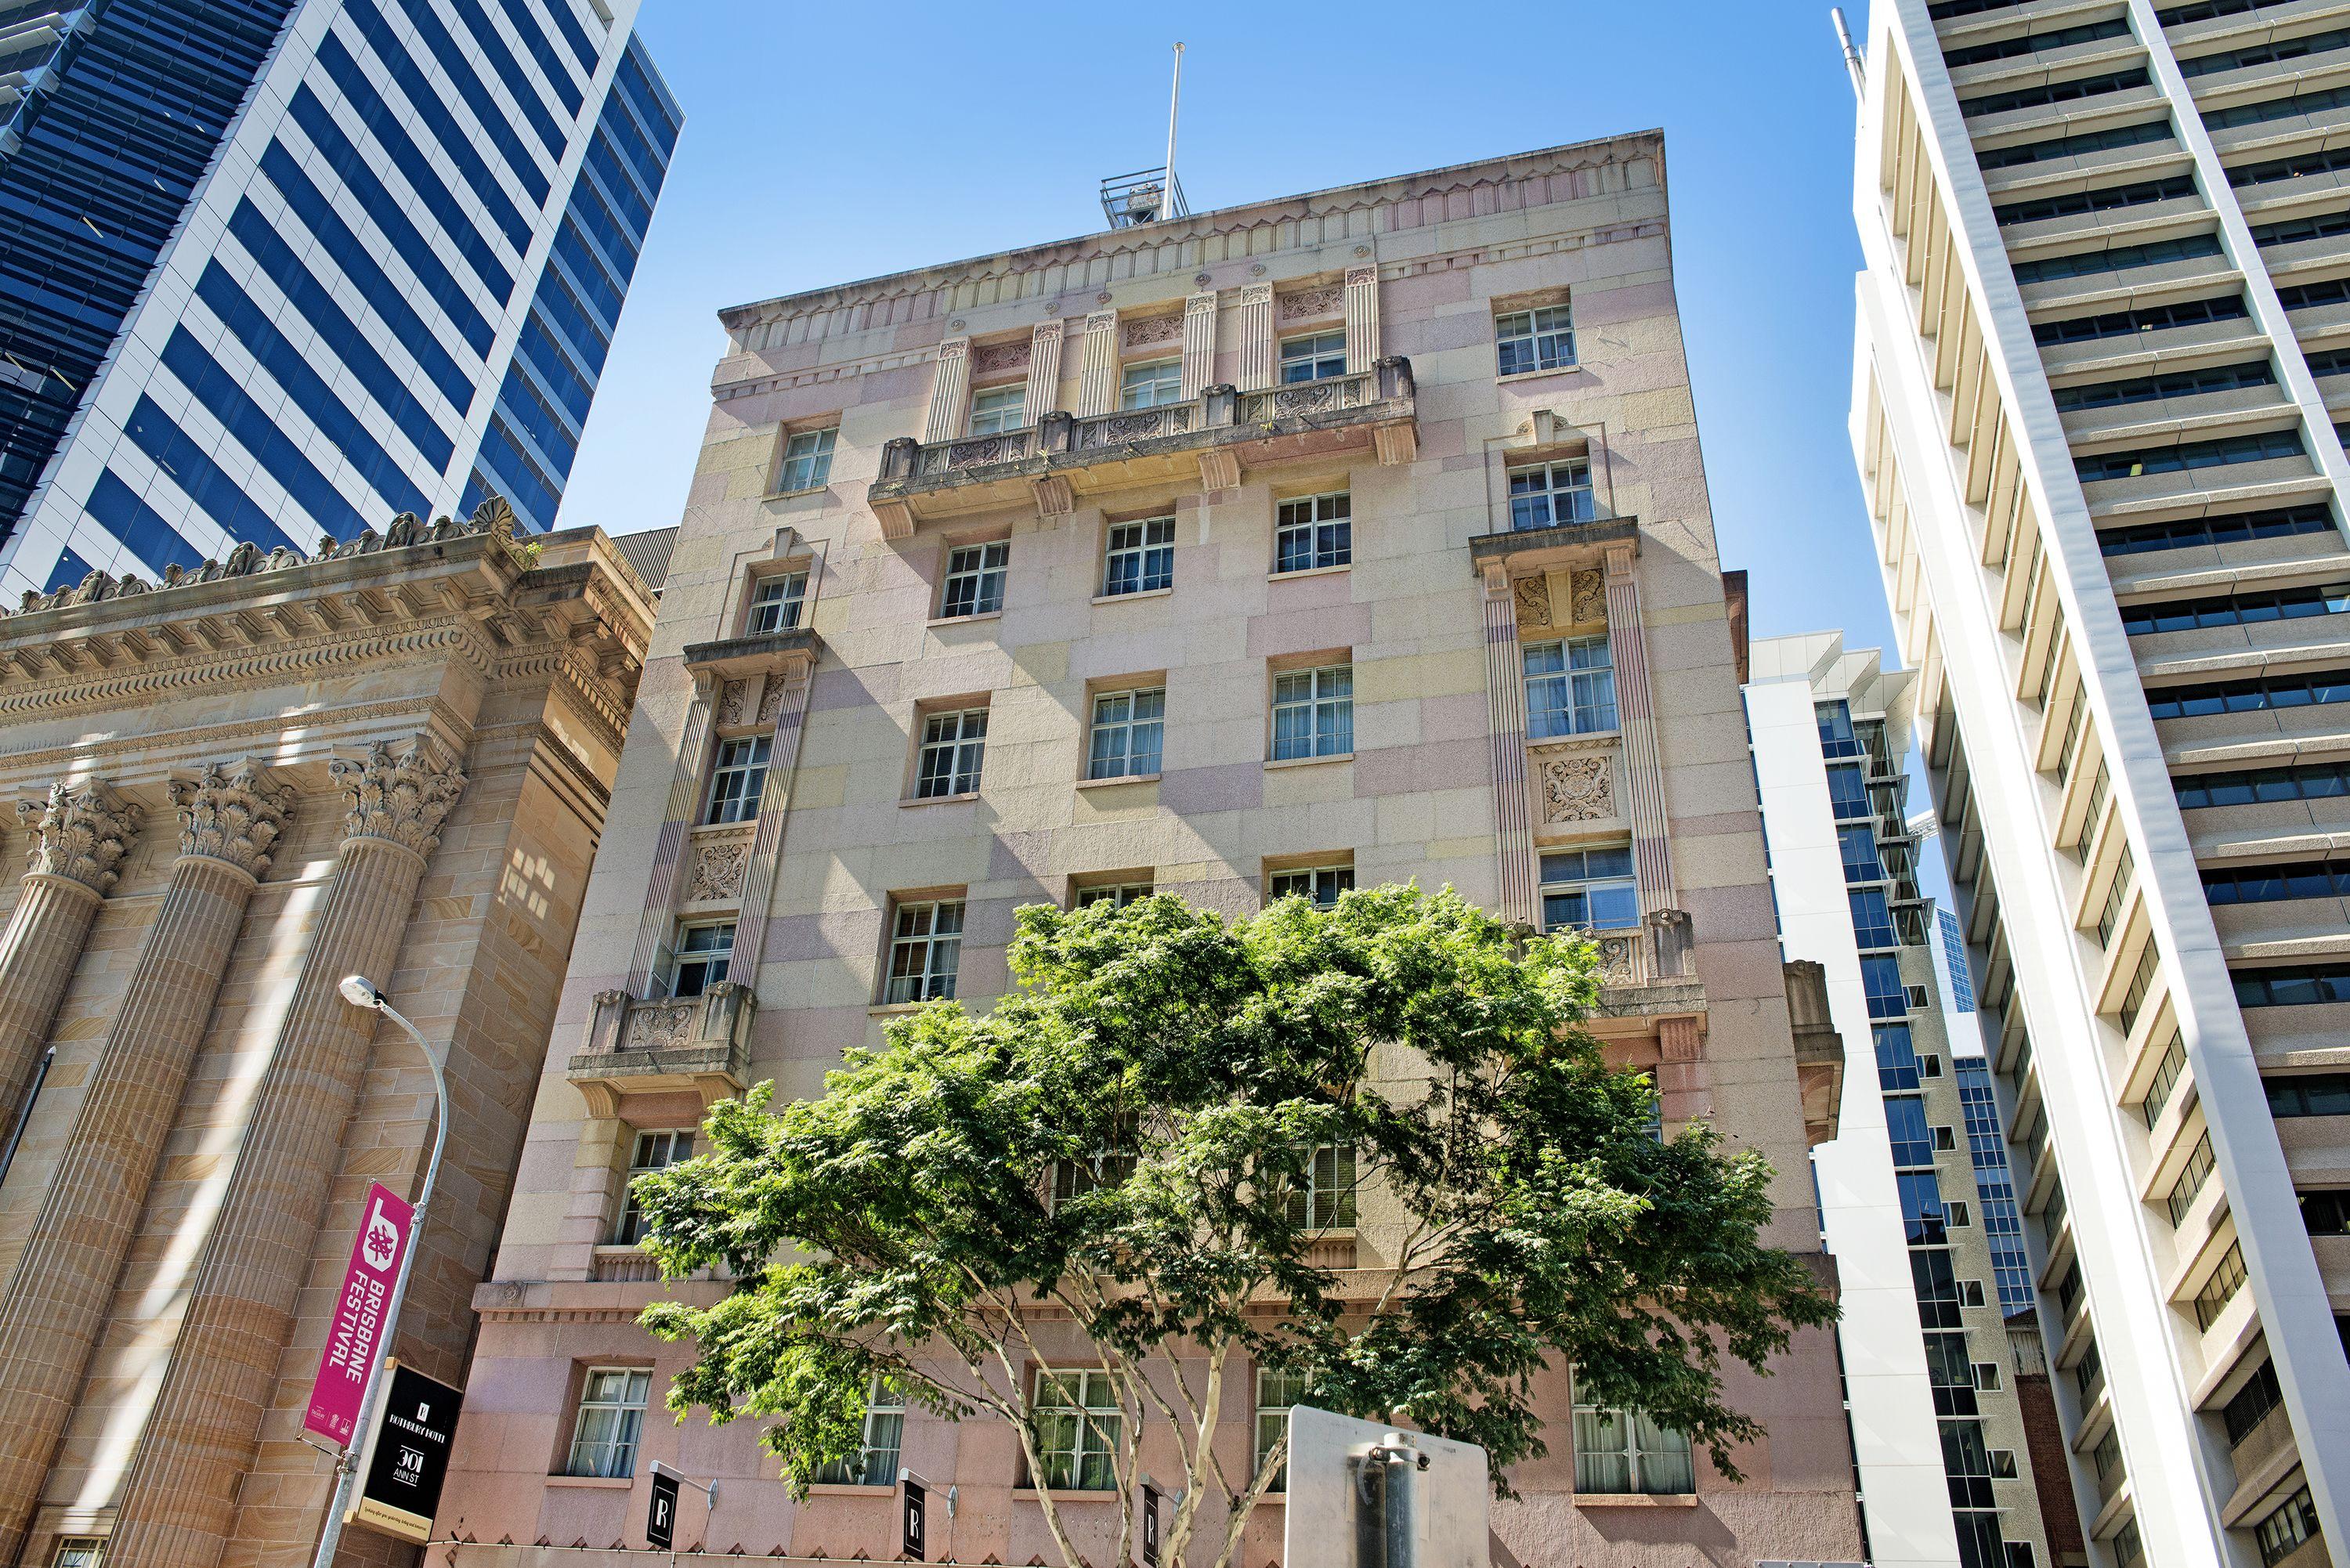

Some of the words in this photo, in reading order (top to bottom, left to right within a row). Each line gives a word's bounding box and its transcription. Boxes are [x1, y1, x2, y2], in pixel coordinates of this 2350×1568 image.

[329, 1270, 369, 1367] FESTIVAL
[345, 1279, 385, 1384] BRISBANE
[389, 1414, 425, 1435] ROTHBURY
[393, 1468, 409, 1480] ANN
[409, 1473, 420, 1483] ST
[397, 1449, 424, 1473] 301
[656, 1498, 668, 1528] R
[909, 1508, 919, 1539] R
[1148, 1513, 1155, 1546] R
